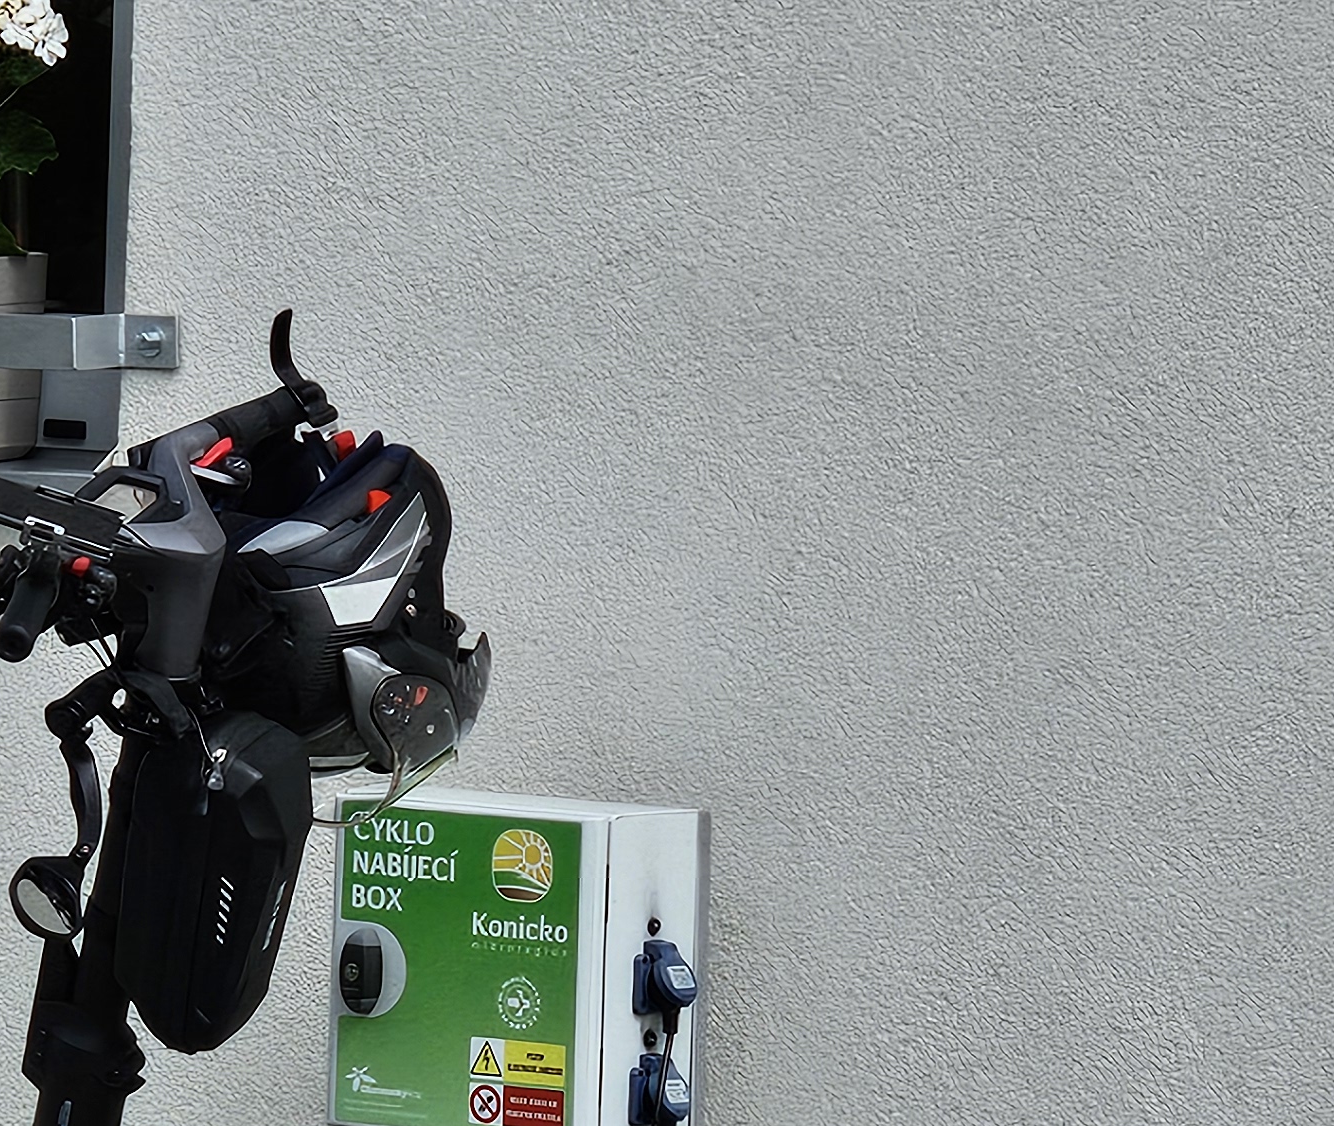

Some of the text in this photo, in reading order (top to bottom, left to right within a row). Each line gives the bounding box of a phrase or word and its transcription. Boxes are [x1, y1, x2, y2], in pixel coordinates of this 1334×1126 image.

[353, 816, 435, 845] CYKLO
[353, 846, 459, 882] NABÍJECÍ
[352, 883, 403, 912] BOX
[472, 911, 568, 943] Konicko
